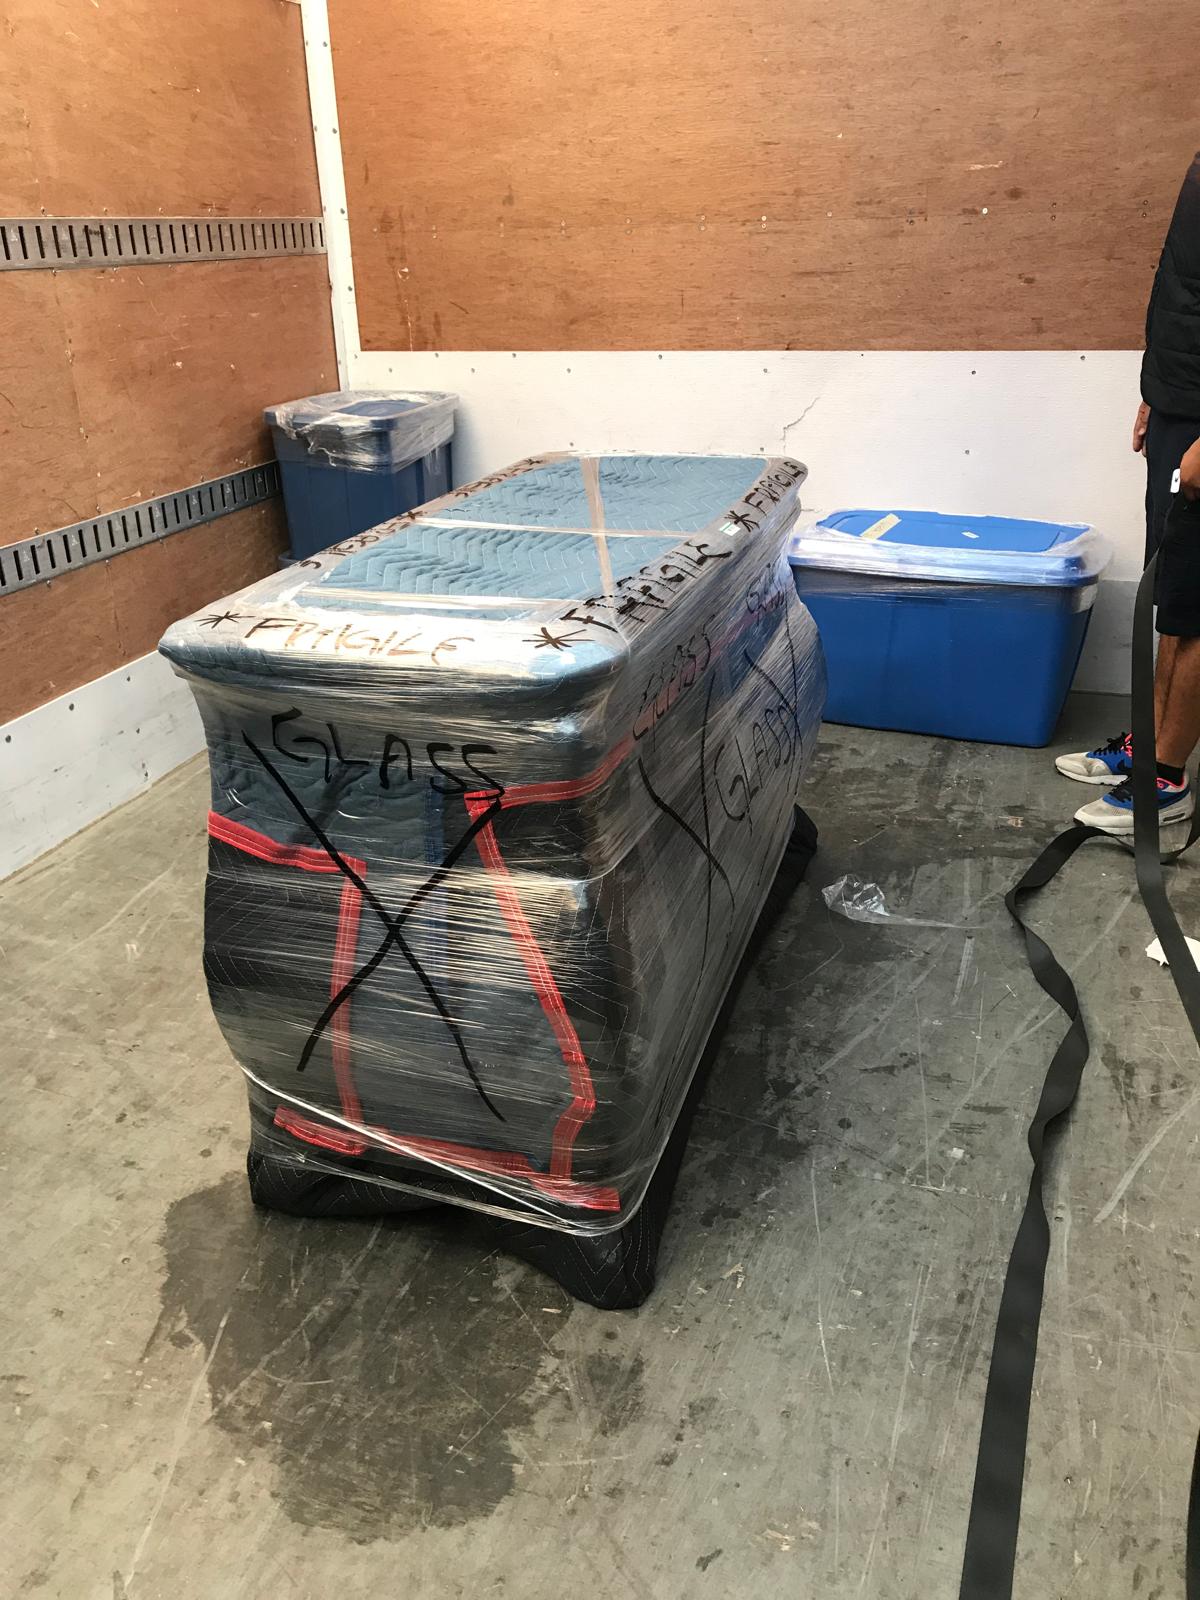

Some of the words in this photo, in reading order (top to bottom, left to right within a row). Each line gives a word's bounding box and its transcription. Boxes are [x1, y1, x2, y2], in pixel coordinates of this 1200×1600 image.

[244, 617, 475, 666] FRAGILE
[271, 706, 505, 797] GLASS
[714, 703, 797, 836] GLASS
